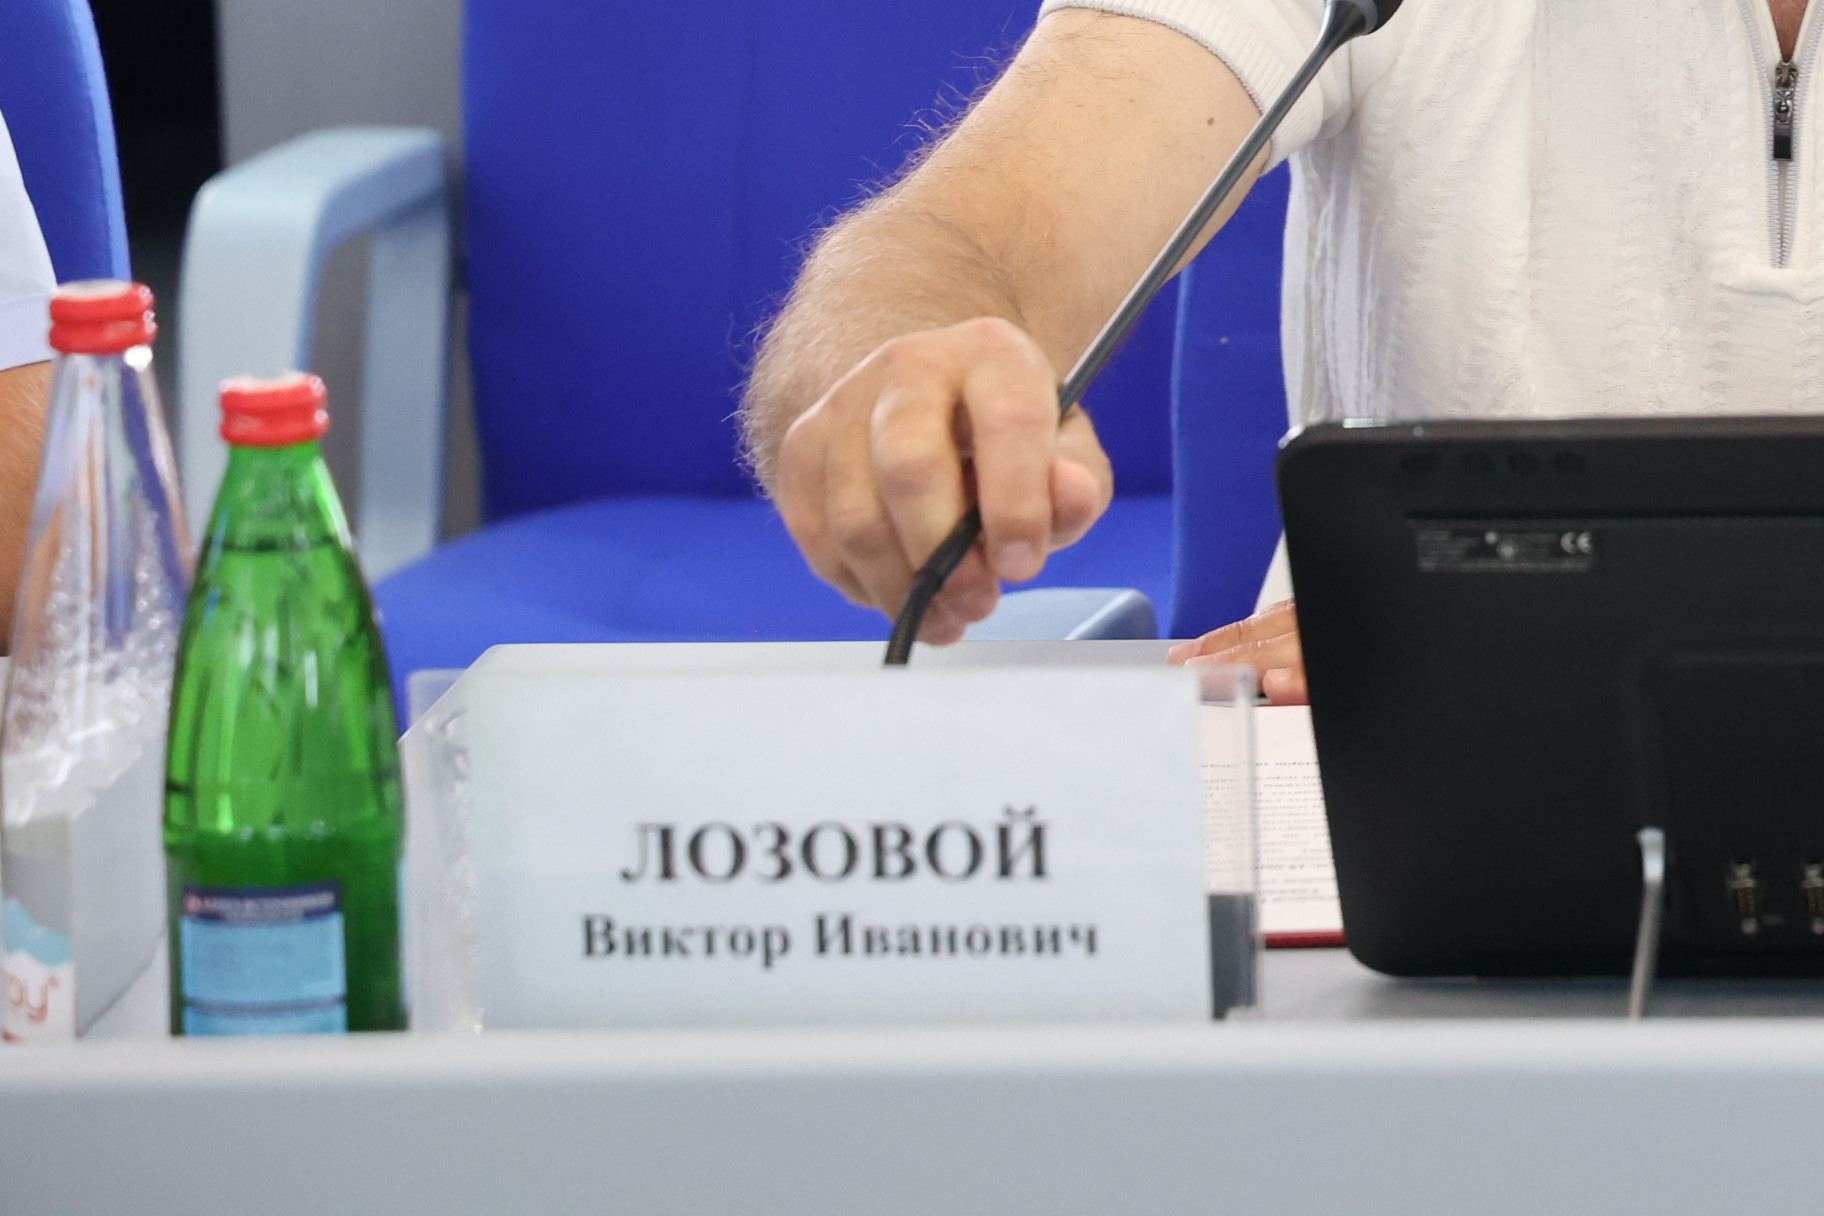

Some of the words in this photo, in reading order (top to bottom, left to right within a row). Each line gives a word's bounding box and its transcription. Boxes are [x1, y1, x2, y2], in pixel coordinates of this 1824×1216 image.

[620, 804, 1050, 884] ЛОЗОВОЙ
[581, 911, 793, 970] Виктор
[813, 910, 1100, 957] Иванович
